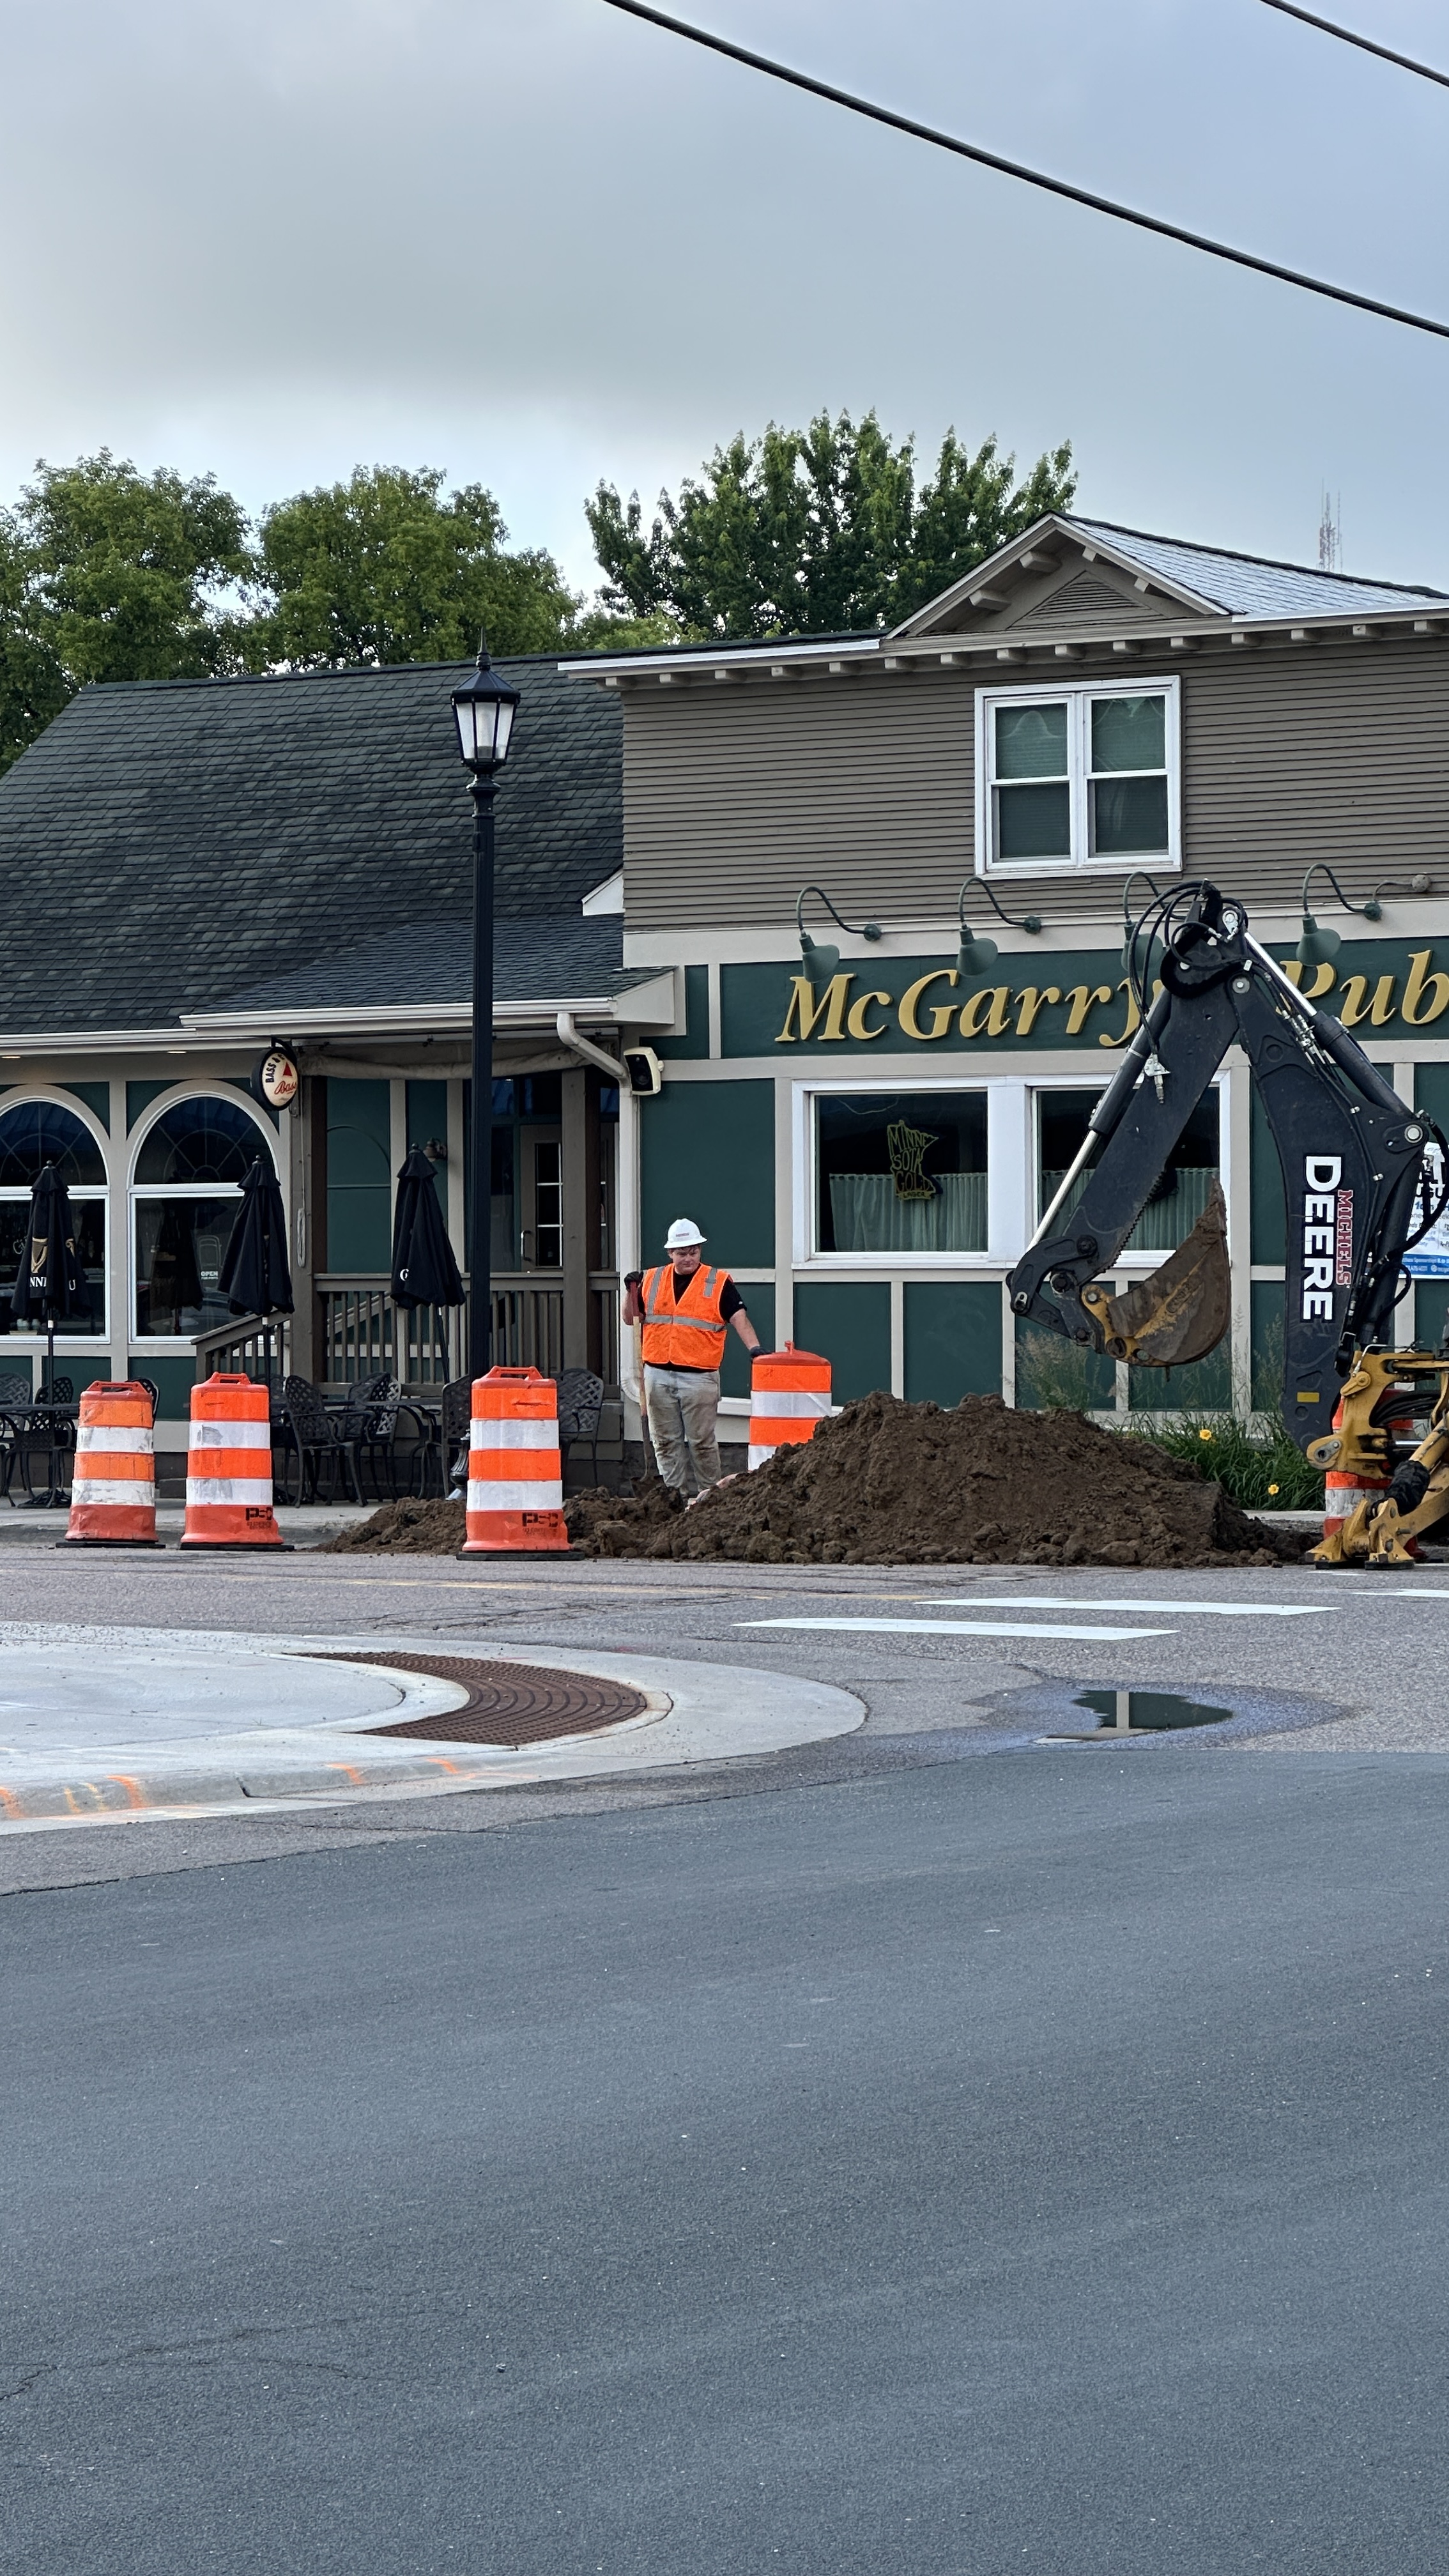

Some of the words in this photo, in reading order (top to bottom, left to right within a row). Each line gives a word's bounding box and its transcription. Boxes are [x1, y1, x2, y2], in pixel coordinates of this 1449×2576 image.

[265, 1062, 277, 1083] BASS
[1303, 1156, 1342, 1321] DEERE
[1336, 1190, 1353, 1285] MICHELS
